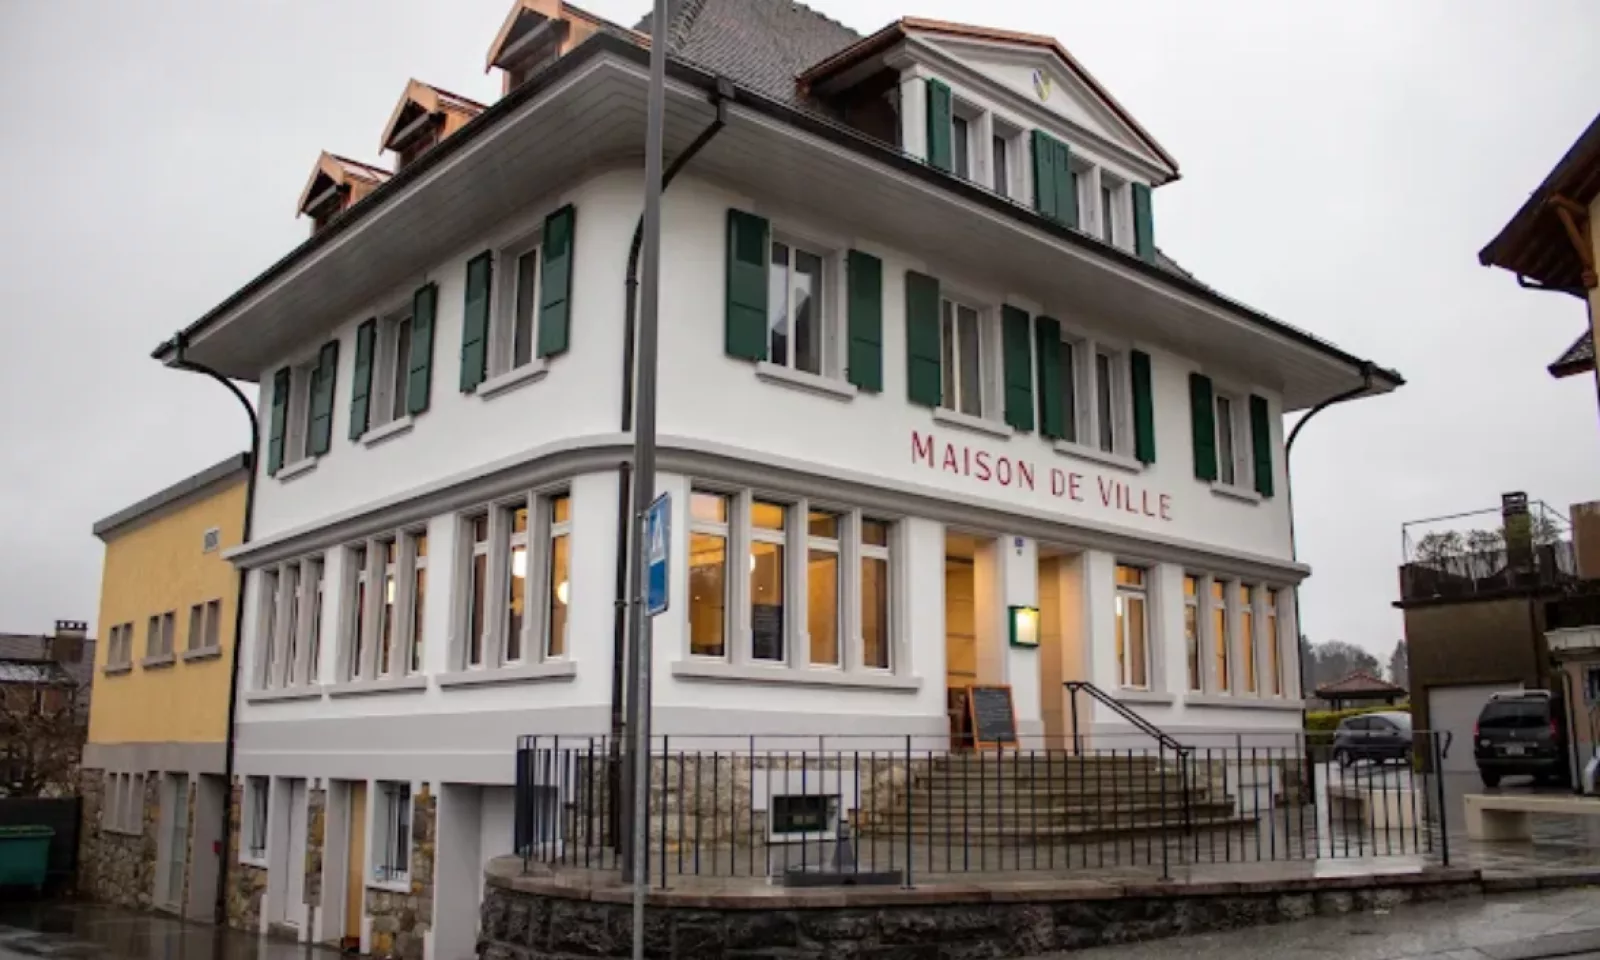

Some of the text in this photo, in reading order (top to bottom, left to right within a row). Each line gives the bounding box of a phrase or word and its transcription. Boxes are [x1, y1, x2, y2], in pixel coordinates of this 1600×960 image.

[911, 430, 1173, 521] MAISON DE VILLE
